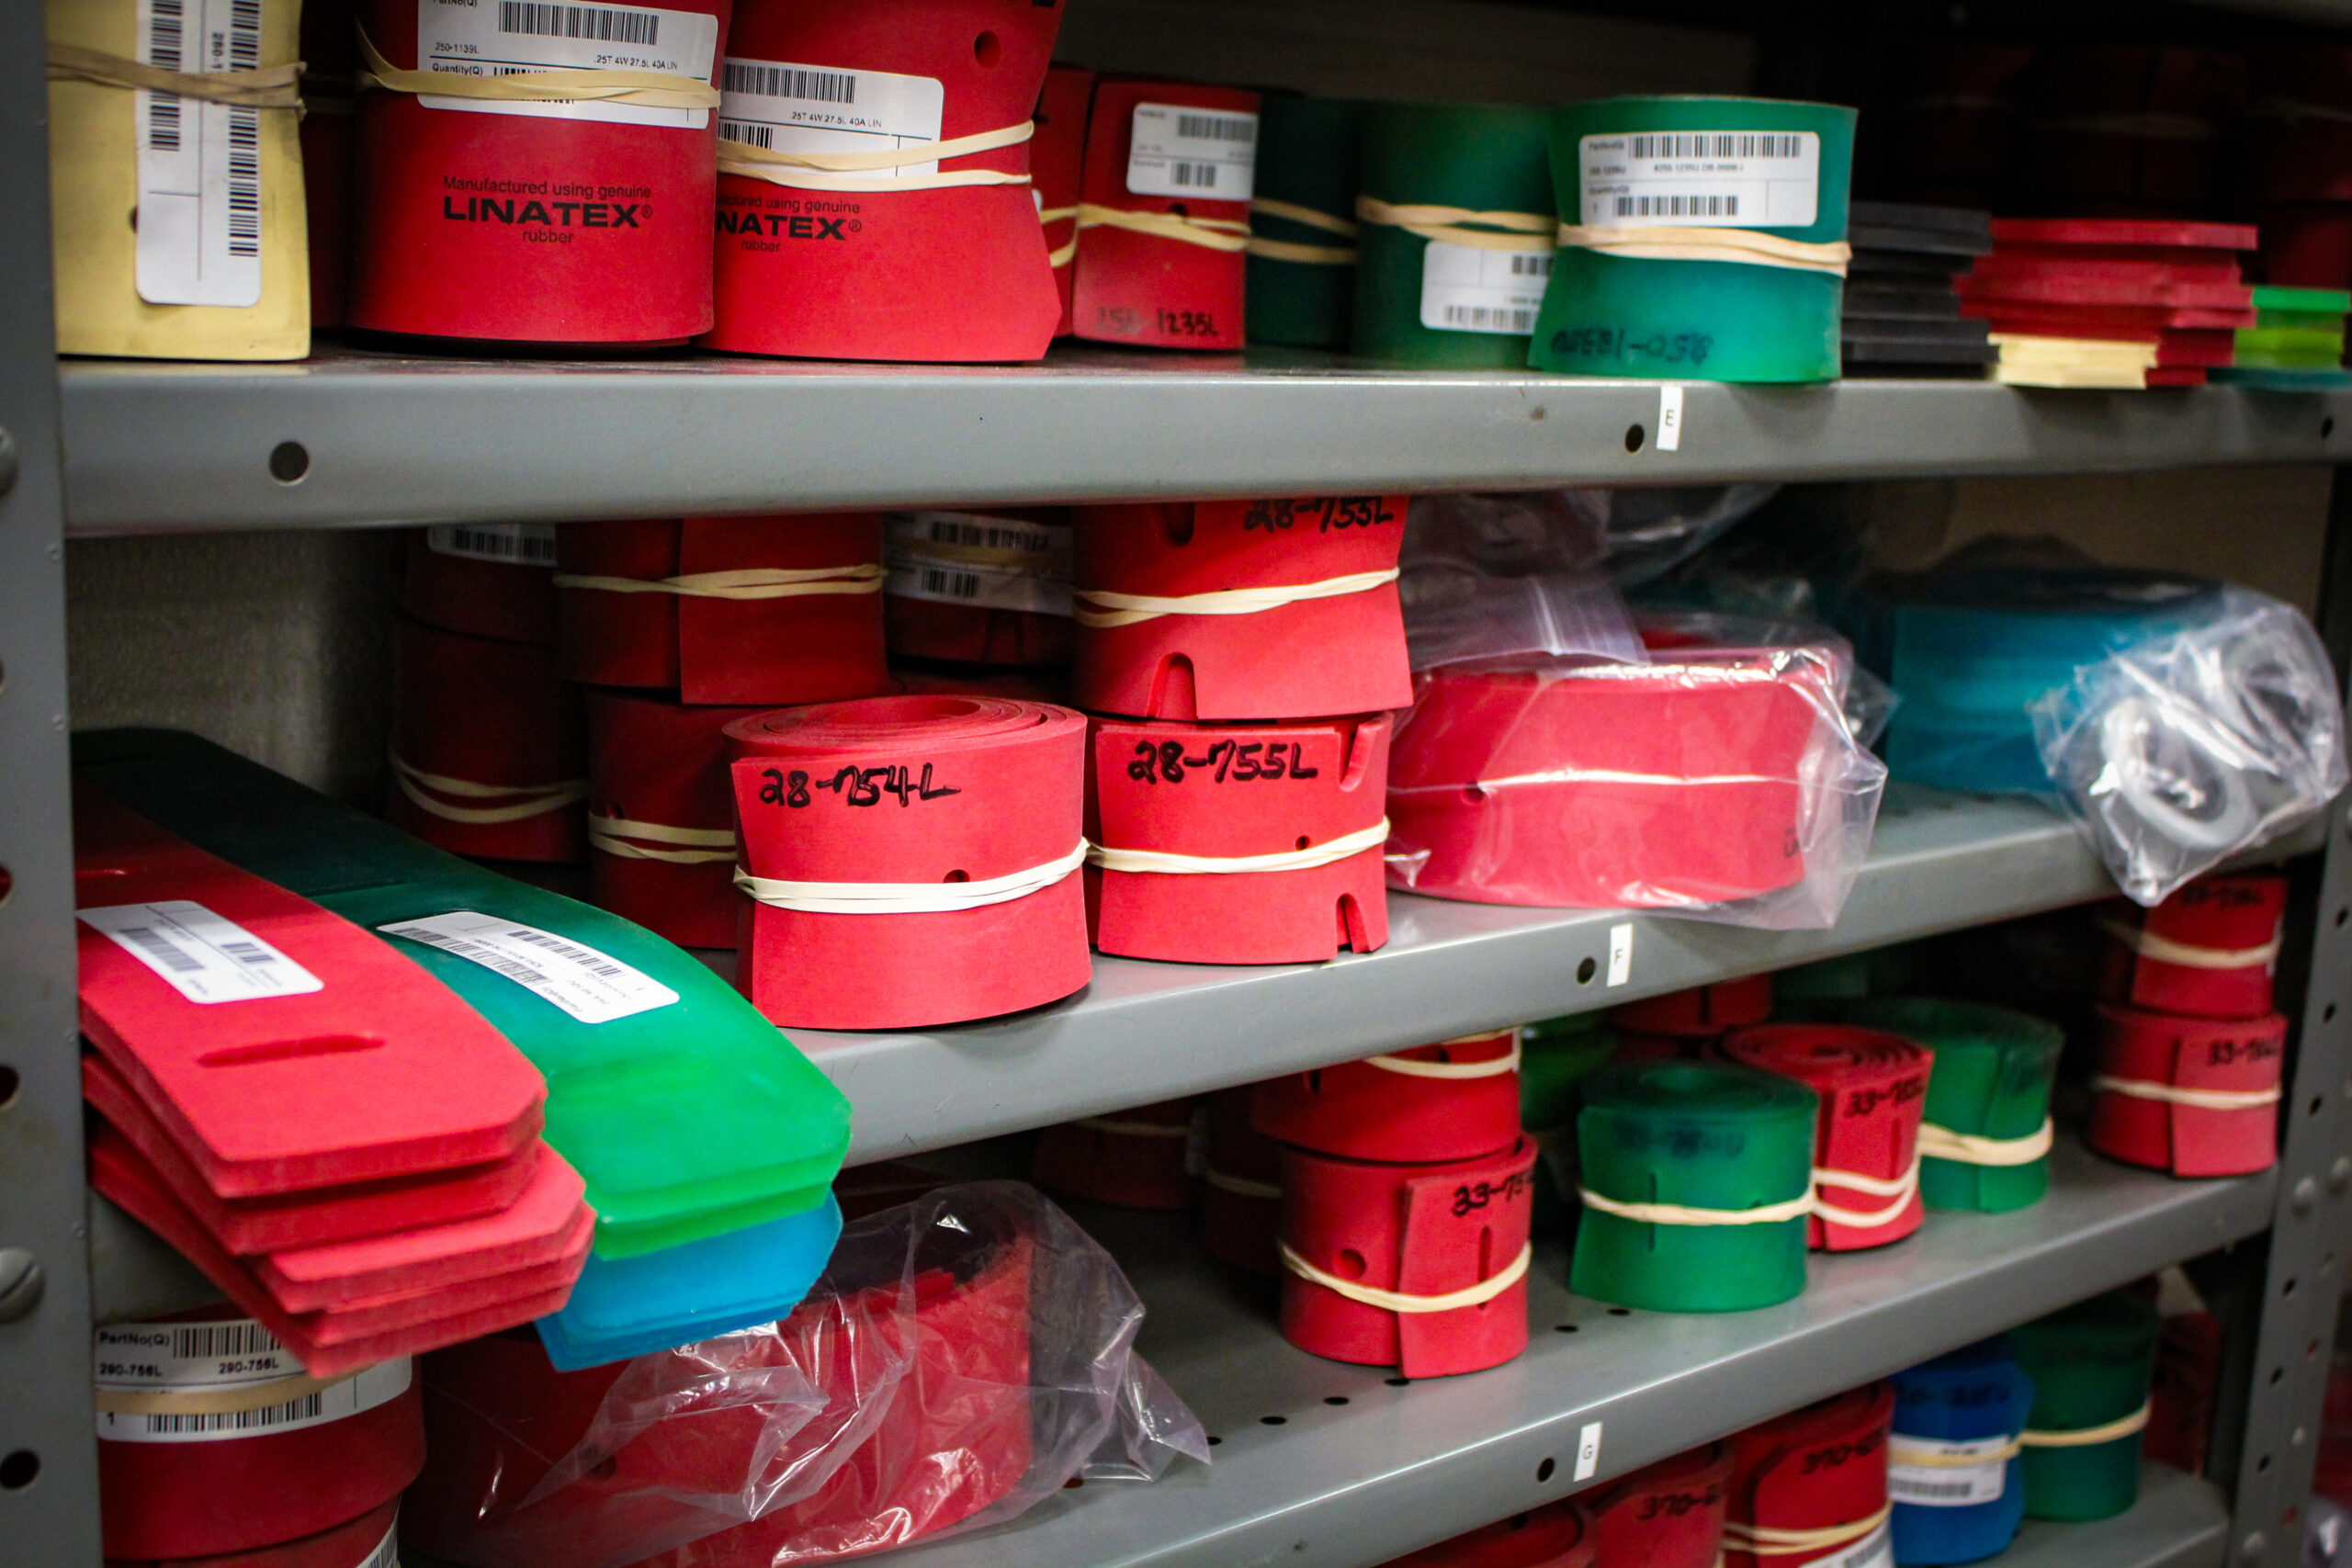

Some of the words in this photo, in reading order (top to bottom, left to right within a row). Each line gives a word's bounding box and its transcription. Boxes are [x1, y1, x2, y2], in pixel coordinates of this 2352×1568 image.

[435, 42, 480, 54] 250-1139L
[433, 62, 483, 76] Quantity(Q)
[868, 118, 882, 128] LIN
[444, 176, 548, 196] Manufactured
[552, 183, 594, 199] using
[597, 185, 651, 200] genuine
[765, 197, 800, 213] using
[805, 200, 860, 214] genuine
[522, 230, 574, 244] rubber
[741, 239, 780, 252] rubber
[1665, 409, 1675, 427] E
[1243, 496, 1395, 534] 28-755L
[1127, 739, 1319, 785] 28-755L
[98, 1333, 170, 1348] PartNo(Q)
[106, 1411, 115, 1427] 1
[1582, 1444, 1593, 1461] G
